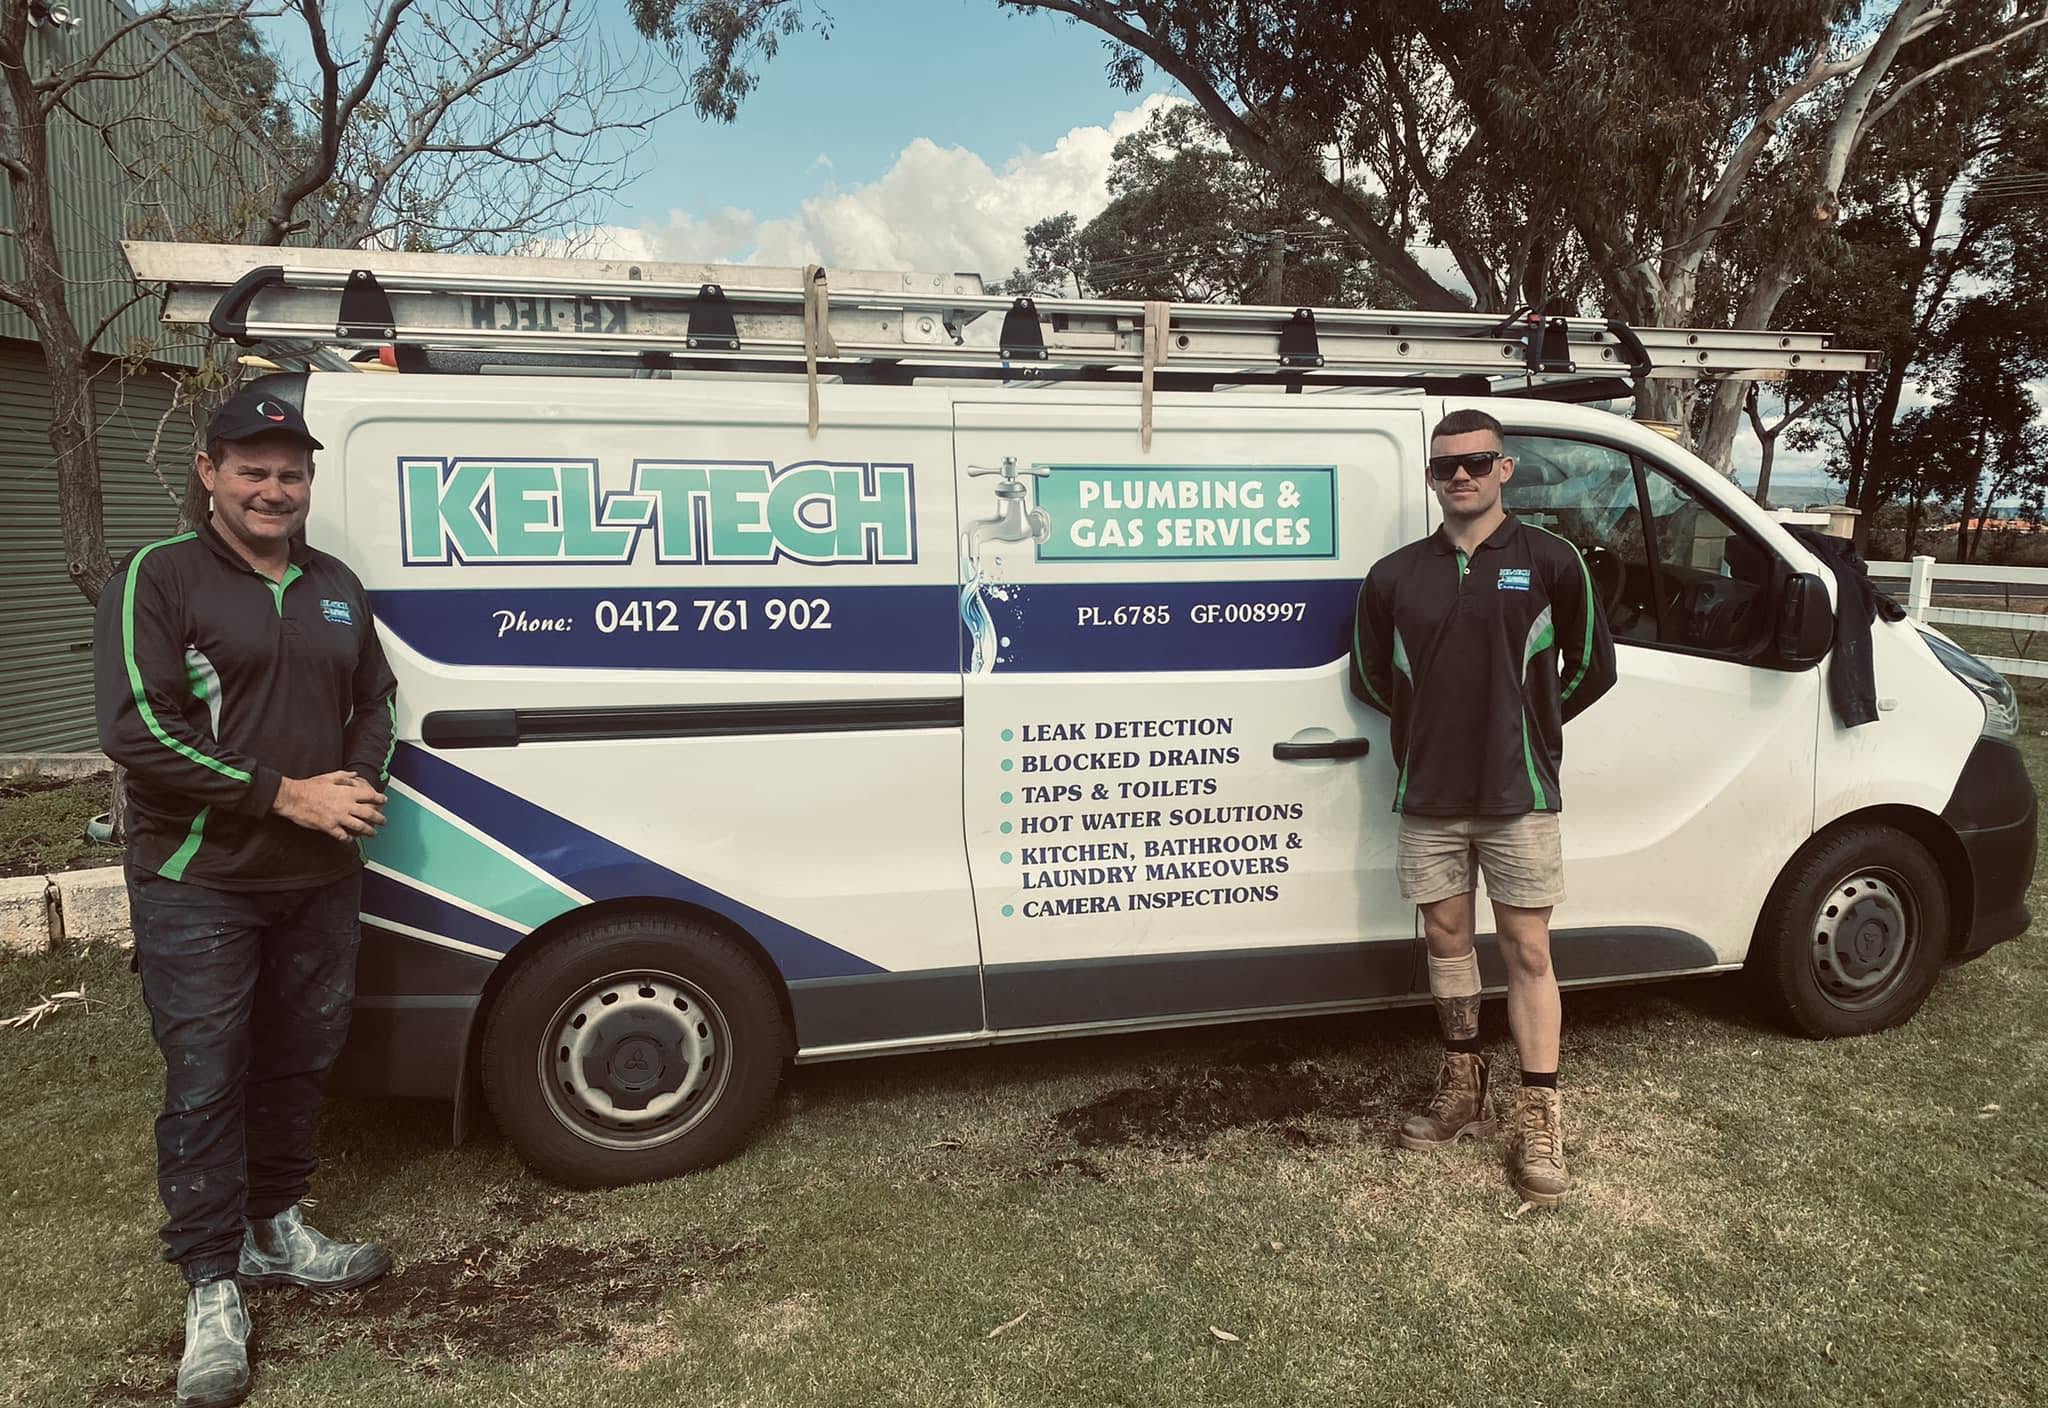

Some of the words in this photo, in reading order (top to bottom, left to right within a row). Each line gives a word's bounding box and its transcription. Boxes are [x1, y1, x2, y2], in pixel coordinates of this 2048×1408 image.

[1079, 480, 1265, 509] PLUMBING
[1276, 480, 1302, 508] &
[397, 456, 919, 568] KEL-TECH
[1069, 518, 1143, 548] GAS
[1156, 517, 1311, 547] SERVICES
[492, 609, 574, 637] Phone:
[594, 600, 679, 633] 0412
[693, 600, 748, 630] 761
[764, 597, 832, 630] 902
[1077, 605, 1171, 627] PL.6785
[1190, 602, 1307, 625] GF.008997
[1022, 723, 1086, 742] LEAK
[1095, 718, 1233, 739] DETECTION
[1022, 750, 1140, 773] BLOCKED
[1149, 747, 1240, 767] DRAINS
[1022, 784, 1082, 804] TAPS
[1091, 784, 1109, 800] &
[1118, 778, 1217, 799] TOILETS
[1020, 816, 1073, 834] HOT
[1081, 810, 1161, 830] WATER
[1169, 803, 1303, 826] SOLUTIONS
[1021, 843, 1136, 866] KITCHEN,
[1144, 834, 1277, 858] BATHROOM
[1285, 832, 1303, 849] &
[1022, 865, 1138, 890] LAUNDRY
[1145, 856, 1289, 881] MAKEOVERS
[1023, 896, 1121, 918] CAMERA
[1128, 885, 1279, 911] INSPECTIONS
